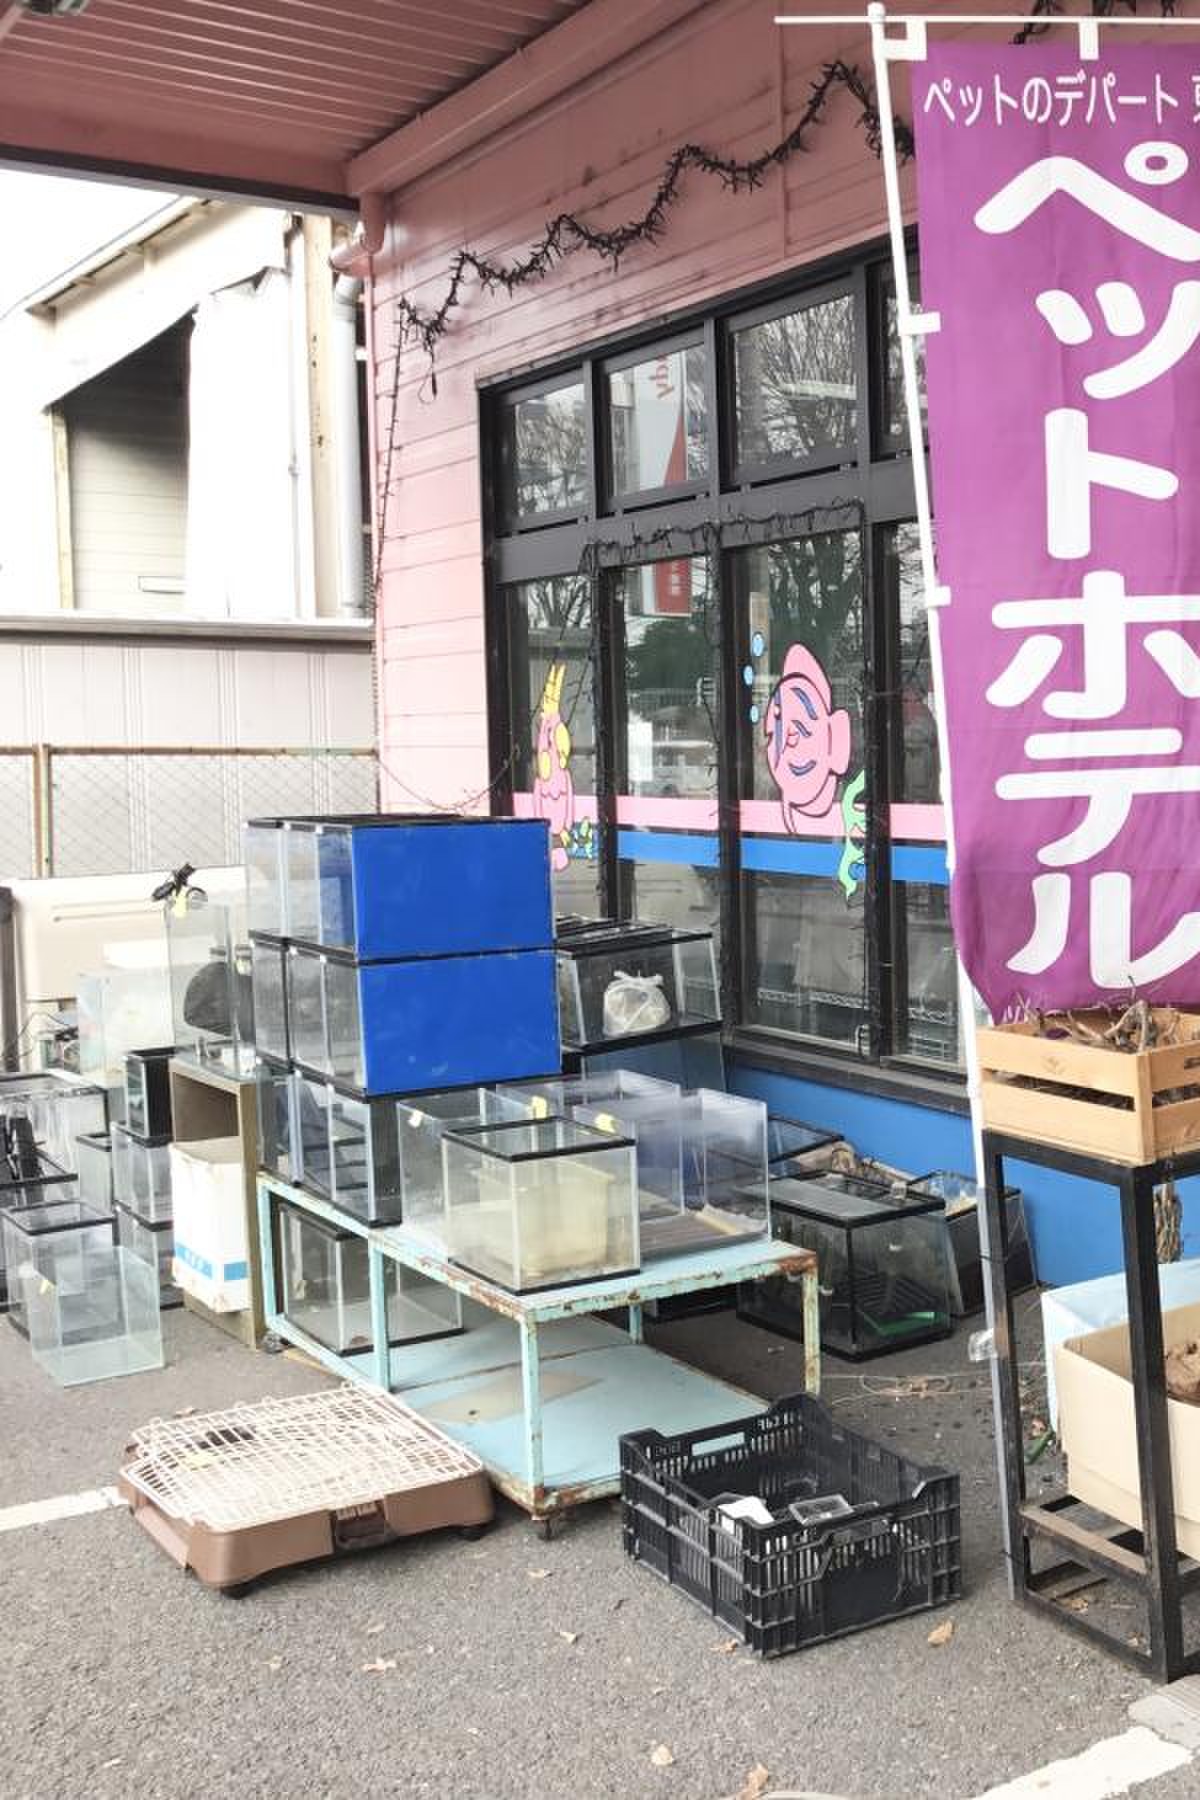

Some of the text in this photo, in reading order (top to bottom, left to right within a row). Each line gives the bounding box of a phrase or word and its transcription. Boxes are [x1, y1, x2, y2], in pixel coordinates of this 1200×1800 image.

[923, 71, 1179, 127] ペットのデパート
